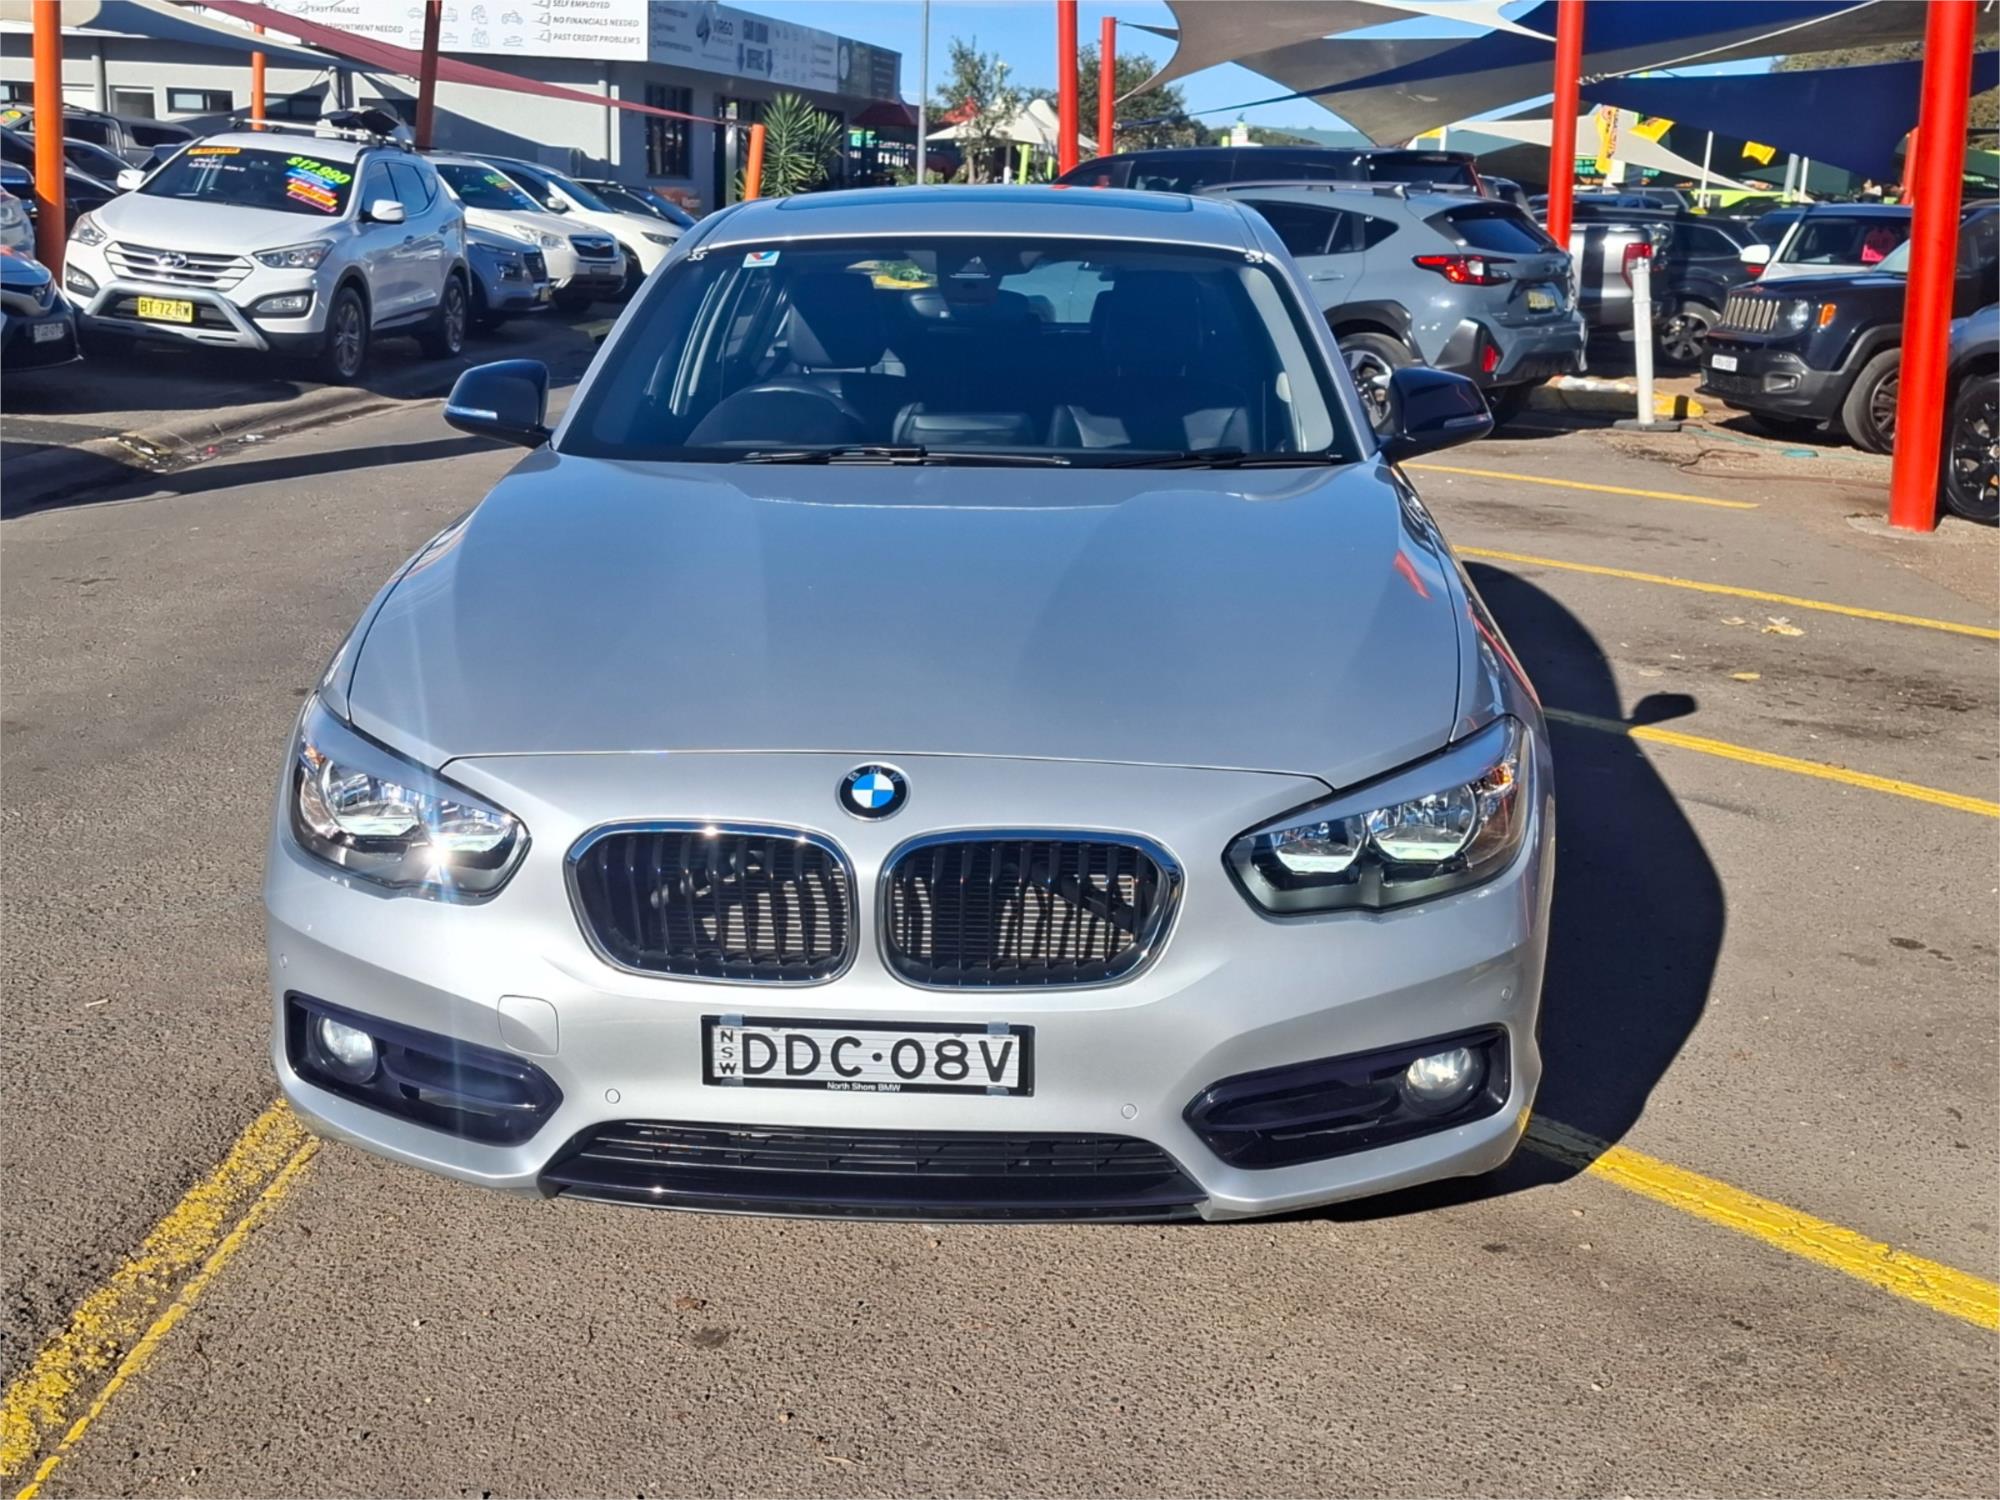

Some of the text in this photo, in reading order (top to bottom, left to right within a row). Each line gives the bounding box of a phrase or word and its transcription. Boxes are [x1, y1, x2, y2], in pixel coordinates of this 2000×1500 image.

[570, 0, 611, 9] EMPLOYED
[330, 6, 361, 15] FINANCE
[552, 16, 640, 28] NO FINANCIALS NEEDED
[374, 24, 404, 34] NEEDED
[552, 32, 572, 42] PAST
[572, 33, 599, 43] CREDIT
[826, 1080, 902, 1093] North Shore BMW
